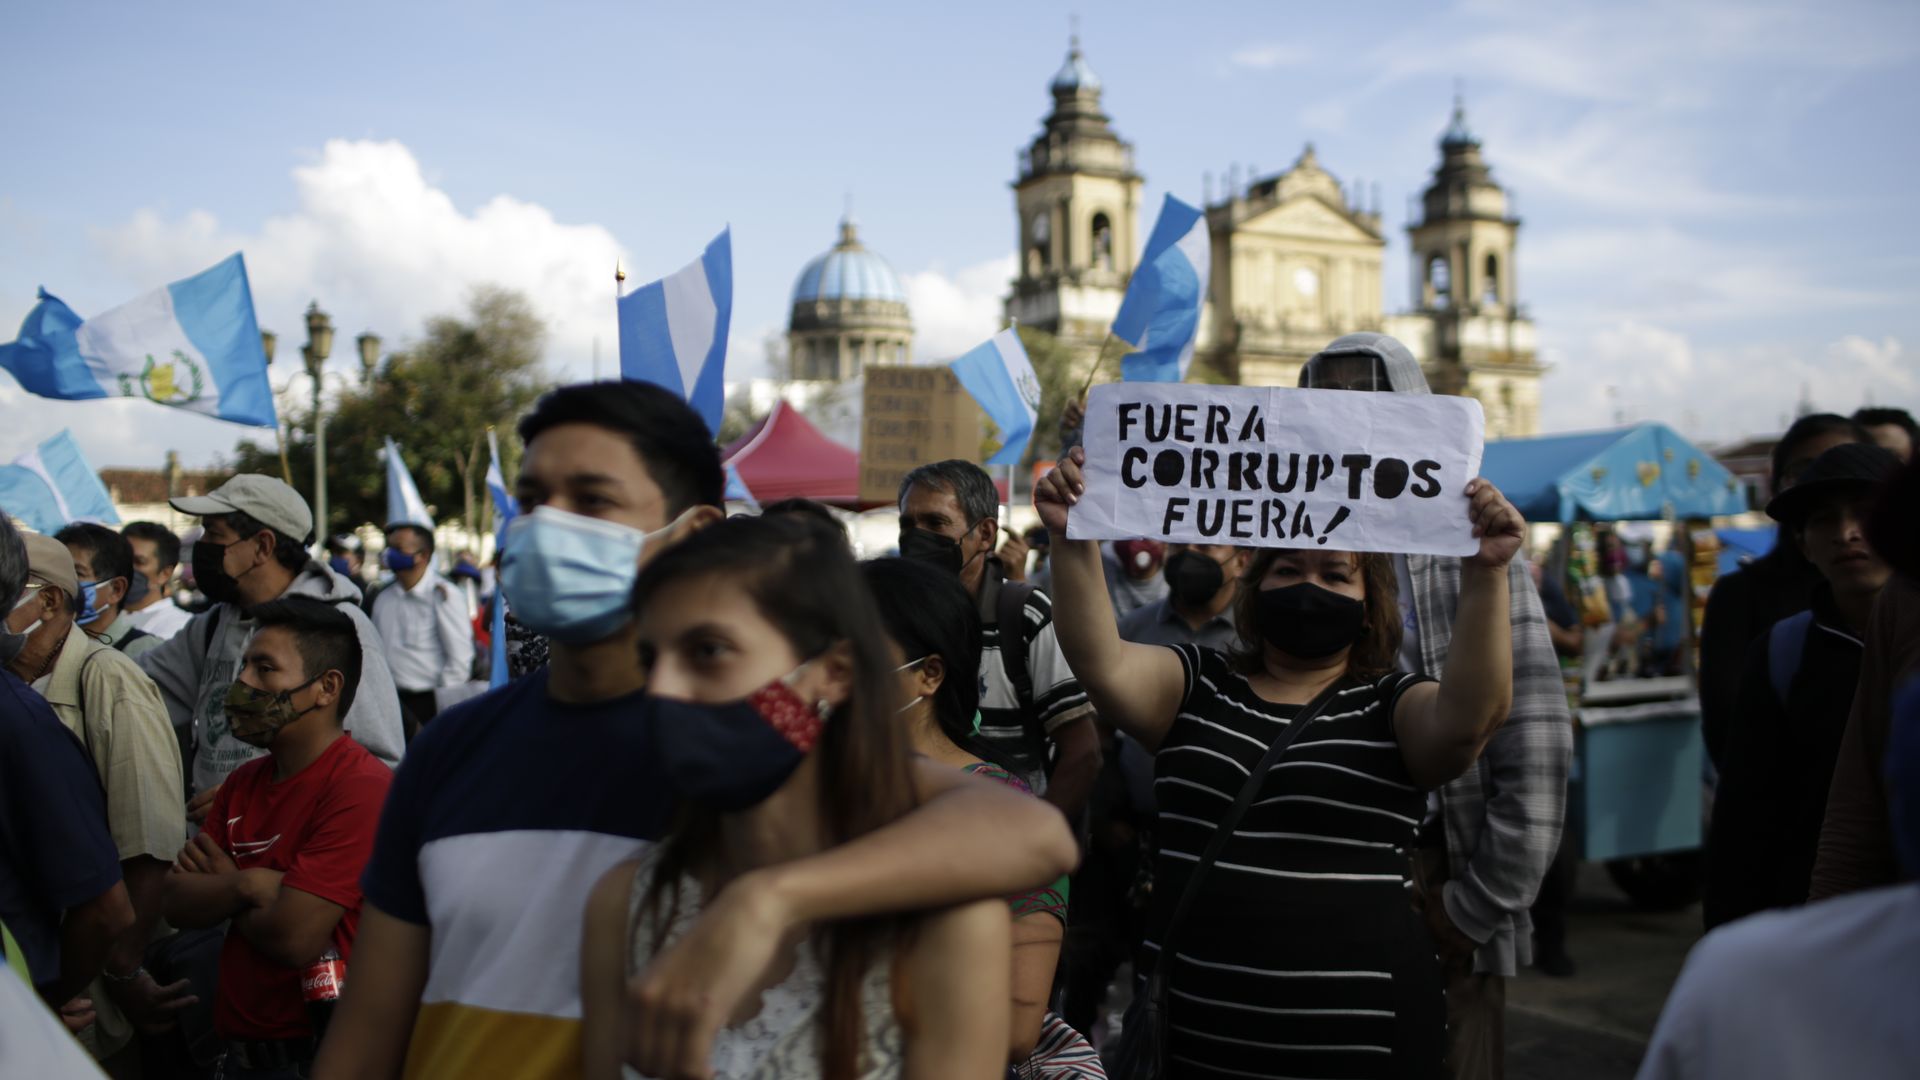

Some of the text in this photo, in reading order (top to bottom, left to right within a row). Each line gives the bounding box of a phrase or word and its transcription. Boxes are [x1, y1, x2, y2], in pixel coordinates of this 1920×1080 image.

[1118, 402, 1265, 444] FUERA
[1120, 446, 1442, 500] CORRUPTOS
[1162, 497, 1351, 546] FUERA!
